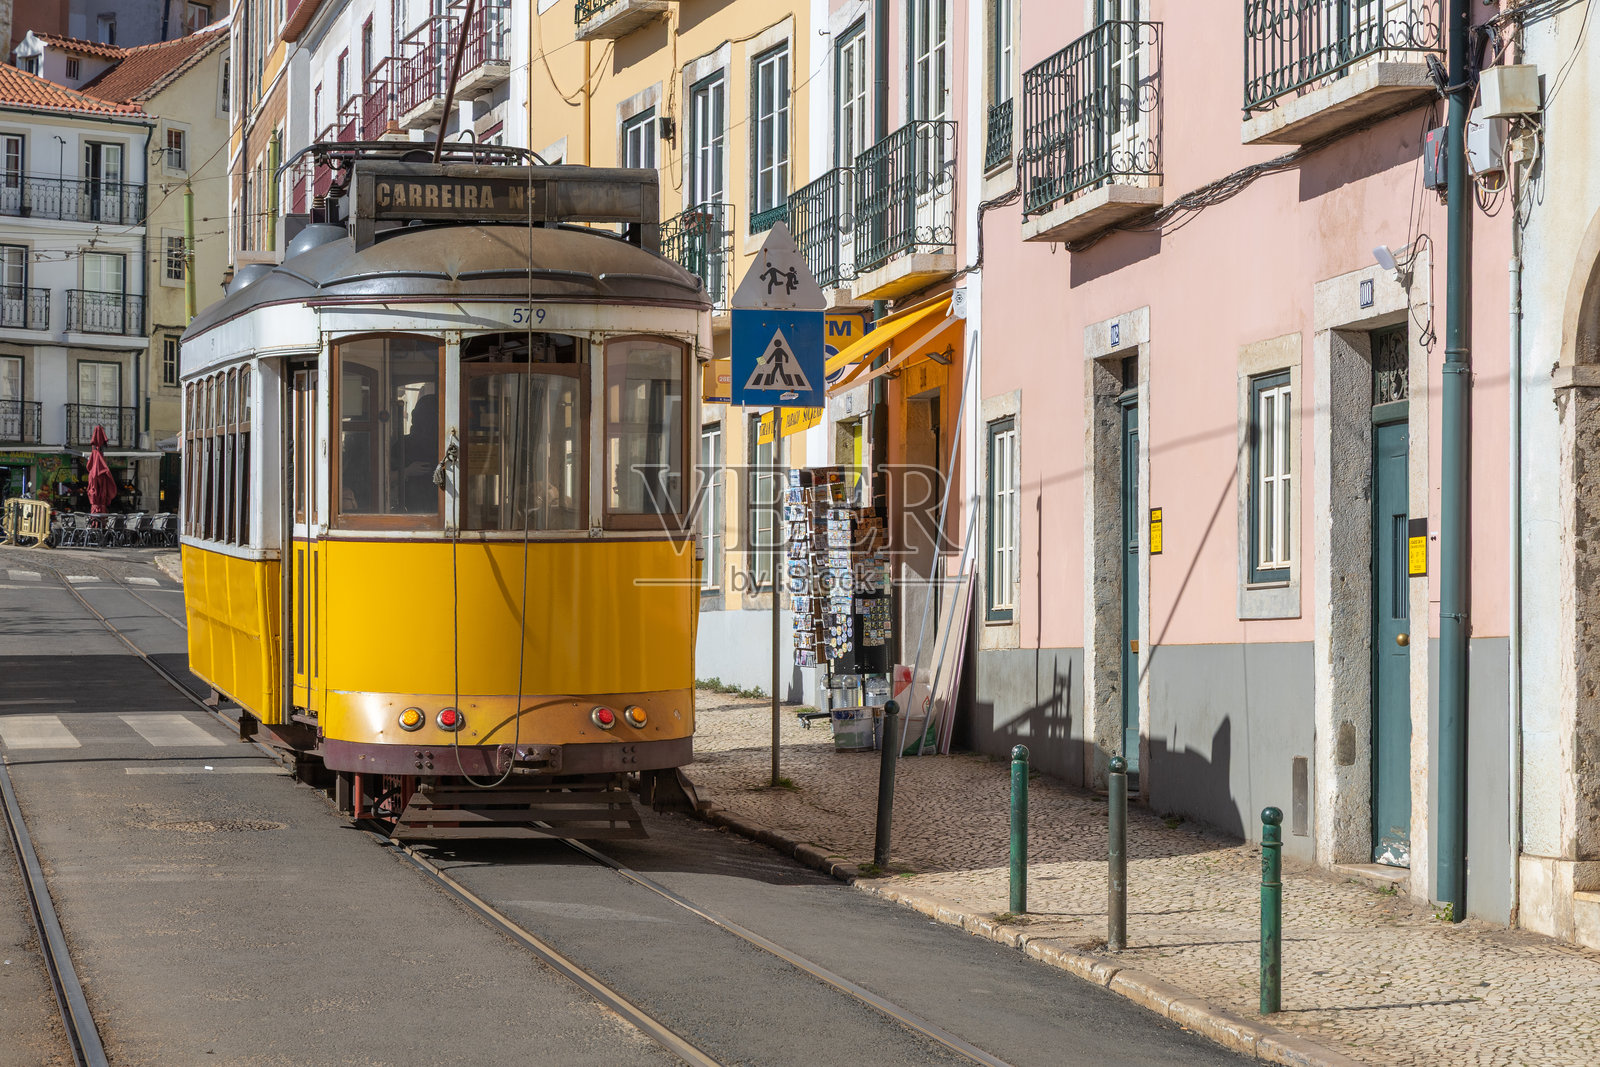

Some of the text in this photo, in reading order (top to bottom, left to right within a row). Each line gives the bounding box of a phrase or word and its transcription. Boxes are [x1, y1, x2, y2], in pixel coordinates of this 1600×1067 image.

[376, 183, 495, 209] CARREIRA
[1360, 281, 1372, 305] 110
[512, 308, 546, 324] 579
